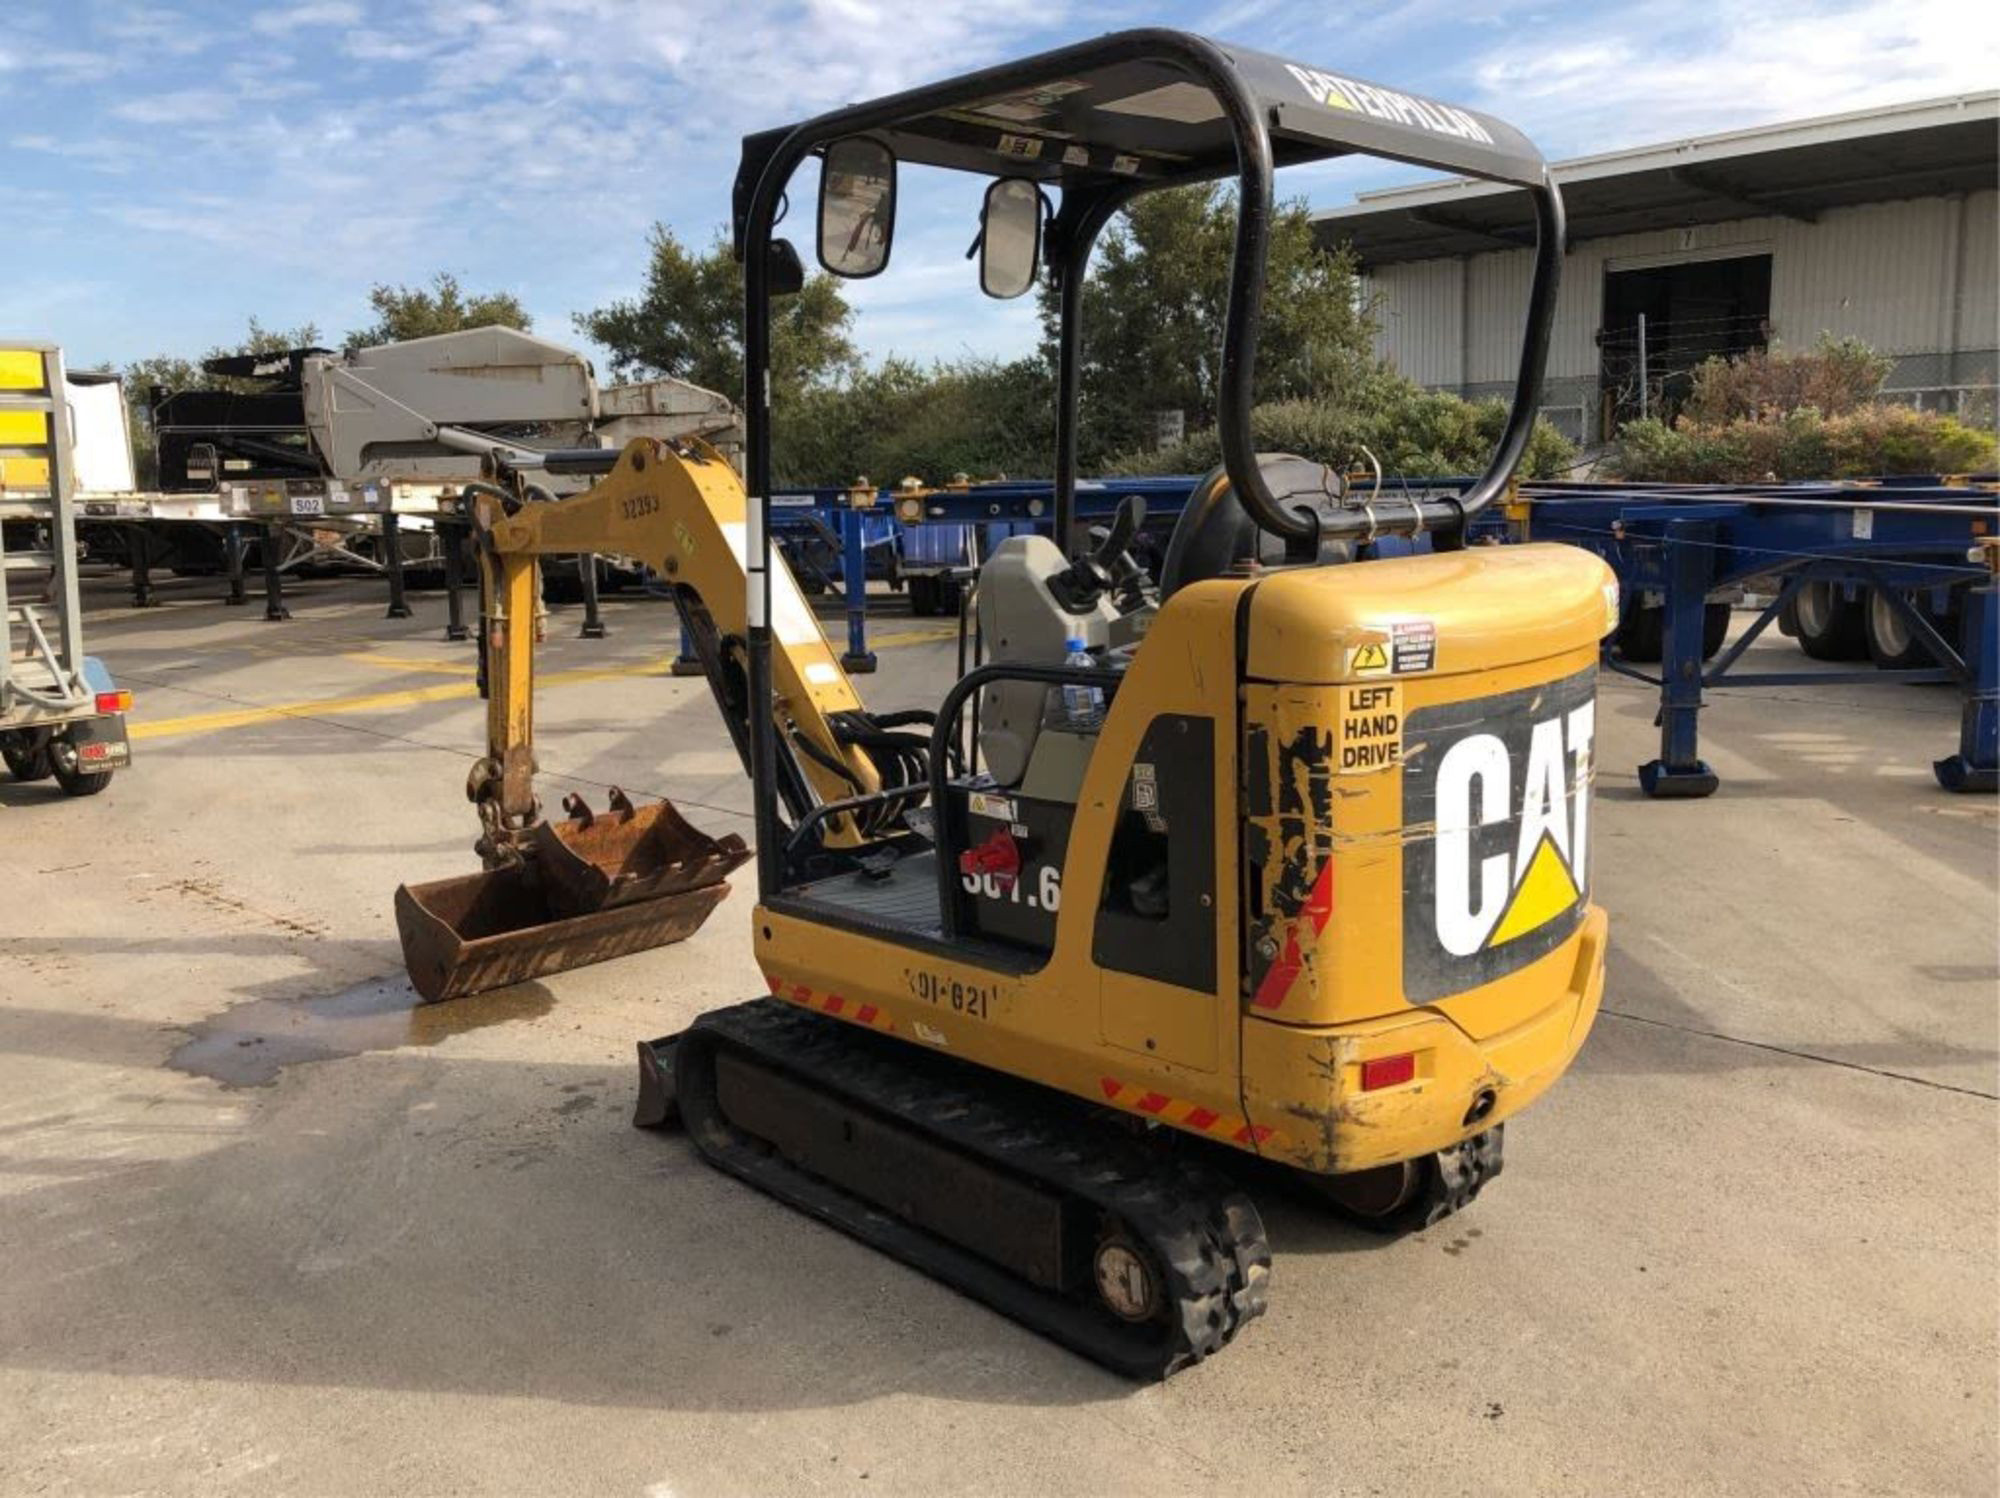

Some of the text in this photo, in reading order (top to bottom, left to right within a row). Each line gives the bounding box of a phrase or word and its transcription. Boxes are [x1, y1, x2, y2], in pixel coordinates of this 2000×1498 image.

[1284, 64, 1495, 145] CATERPILLAR
[1349, 687, 1394, 711] LEFT
[1345, 714, 1398, 740] HAND
[1343, 742, 1400, 768] DRIVE
[1435, 699, 1595, 957] CAT
